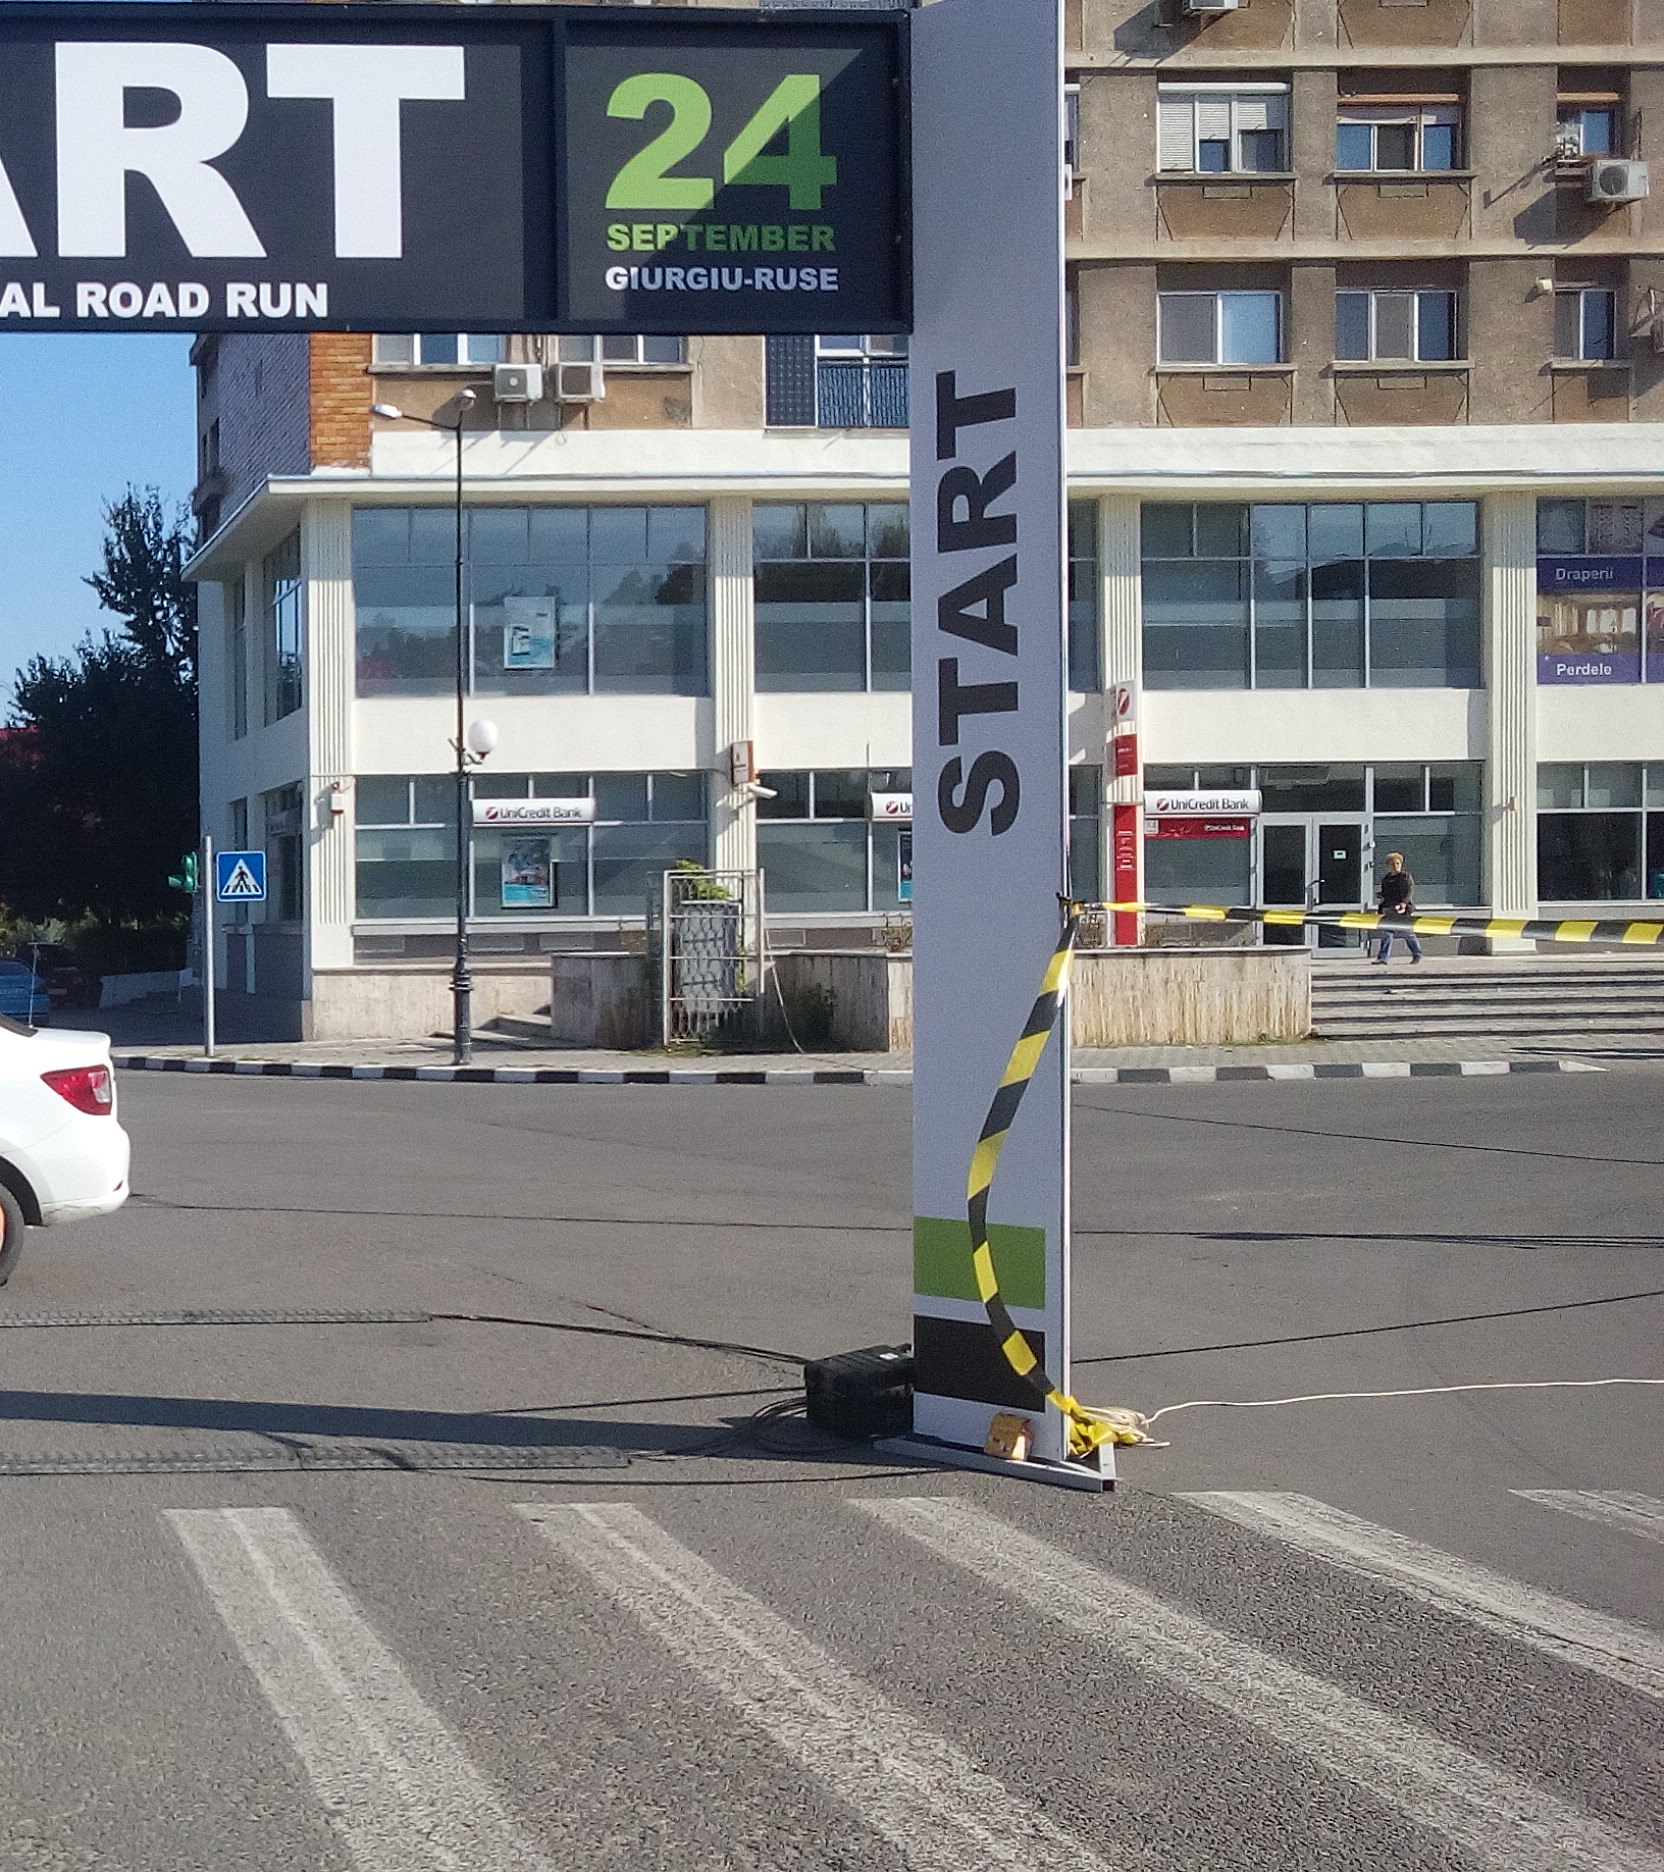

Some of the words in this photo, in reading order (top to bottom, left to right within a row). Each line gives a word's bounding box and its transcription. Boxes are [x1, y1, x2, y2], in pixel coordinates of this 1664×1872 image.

[605, 73, 837, 211] 24
[606, 222, 836, 251] SEPTEMBER
[605, 266, 839, 292] GIURGIU-RUSE
[75, 281, 211, 319] ROAD
[225, 281, 331, 319] RUN
[935, 369, 1021, 837] START
[1556, 663, 1612, 676] Perdele
[500, 806, 551, 819] UniCredit
[553, 806, 582, 819] Bank
[1170, 797, 1220, 810] UniCredit
[1221, 797, 1249, 810] Bank
